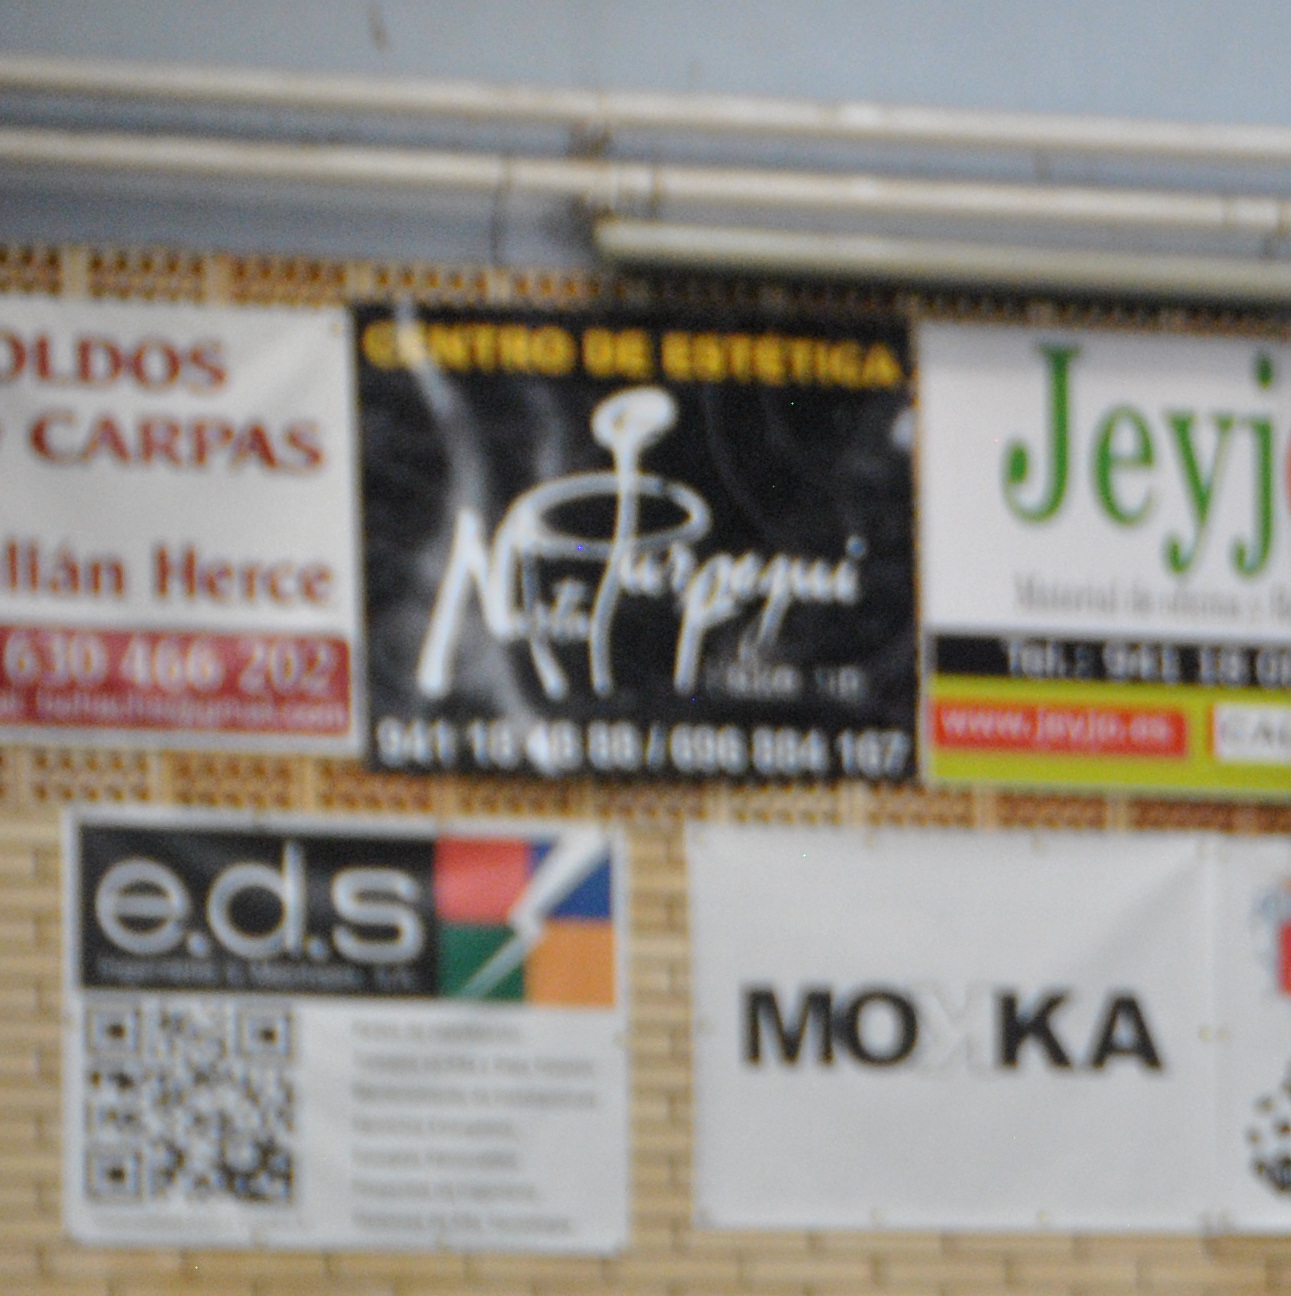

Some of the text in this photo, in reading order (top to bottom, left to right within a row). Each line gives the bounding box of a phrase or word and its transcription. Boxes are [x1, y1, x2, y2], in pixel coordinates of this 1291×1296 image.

[29, 408, 325, 478] CARPAS
[153, 538, 335, 604] Herce
[121, 631, 226, 695] 466
[237, 637, 337, 697] 202
[94, 840, 428, 964] e.d.s
